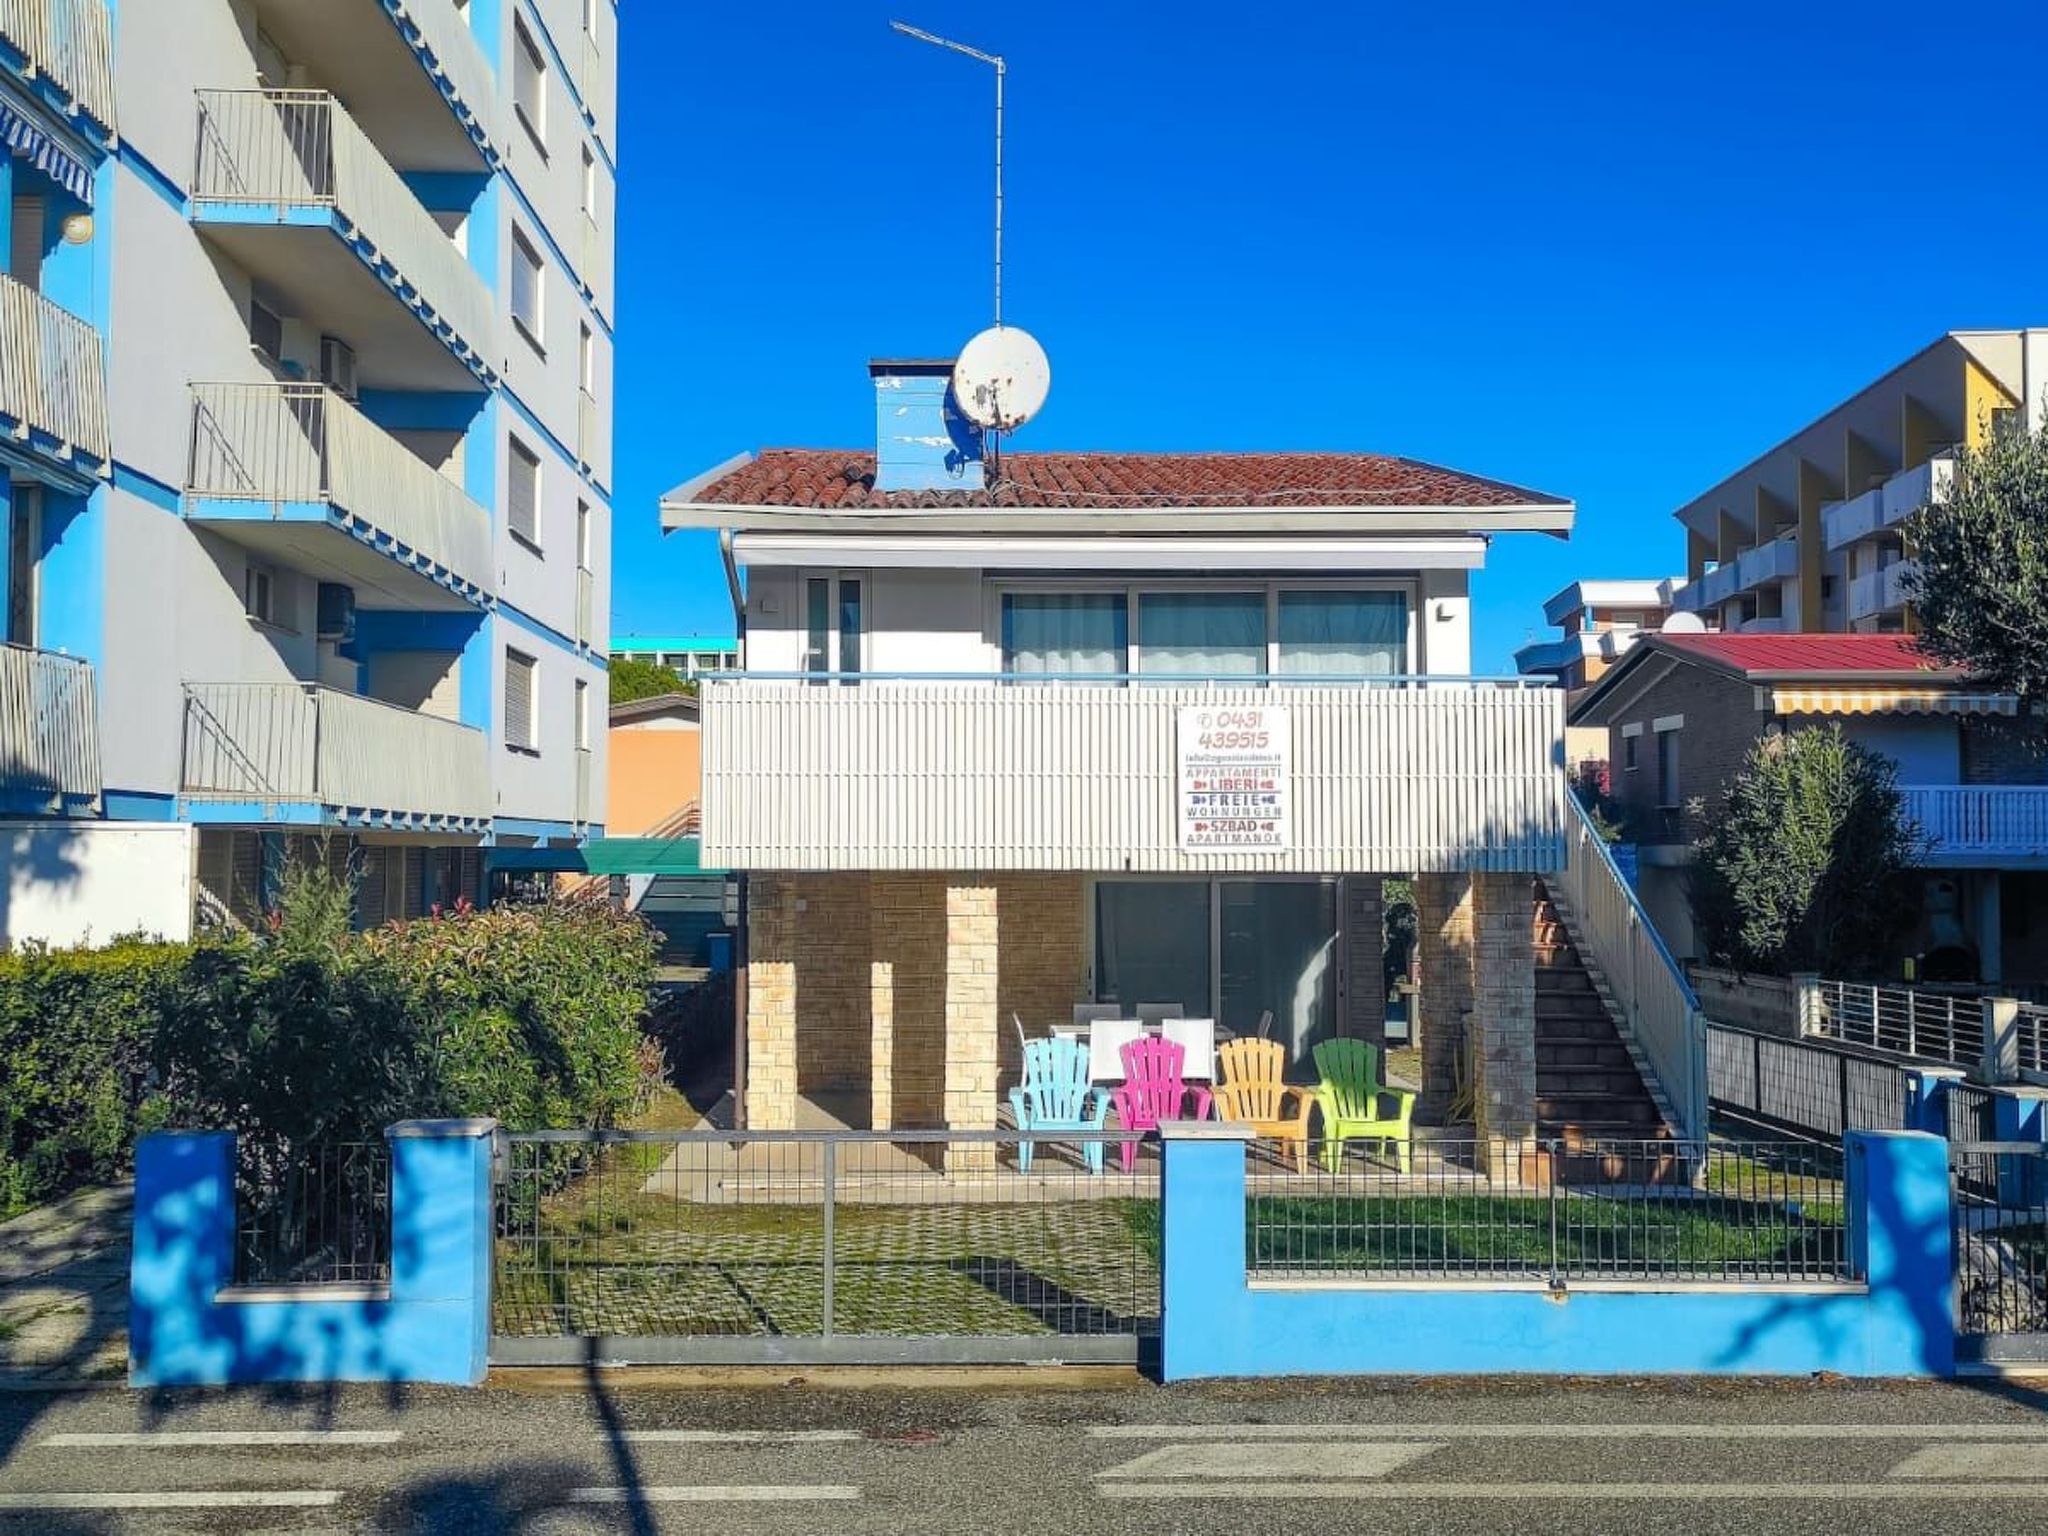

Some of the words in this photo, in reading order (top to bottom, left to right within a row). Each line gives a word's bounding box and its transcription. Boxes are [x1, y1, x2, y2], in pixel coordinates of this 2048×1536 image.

[1217, 711, 1263, 729] 0431
[1199, 731, 1270, 749] 439515
[1186, 768, 1281, 779] APPARTAMENTI
[1210, 779, 1258, 791] LIBERI
[1209, 794, 1260, 806] FREIE
[1187, 807, 1282, 817] WOHNUNGEN
[1211, 820, 1258, 832] SZBAD
